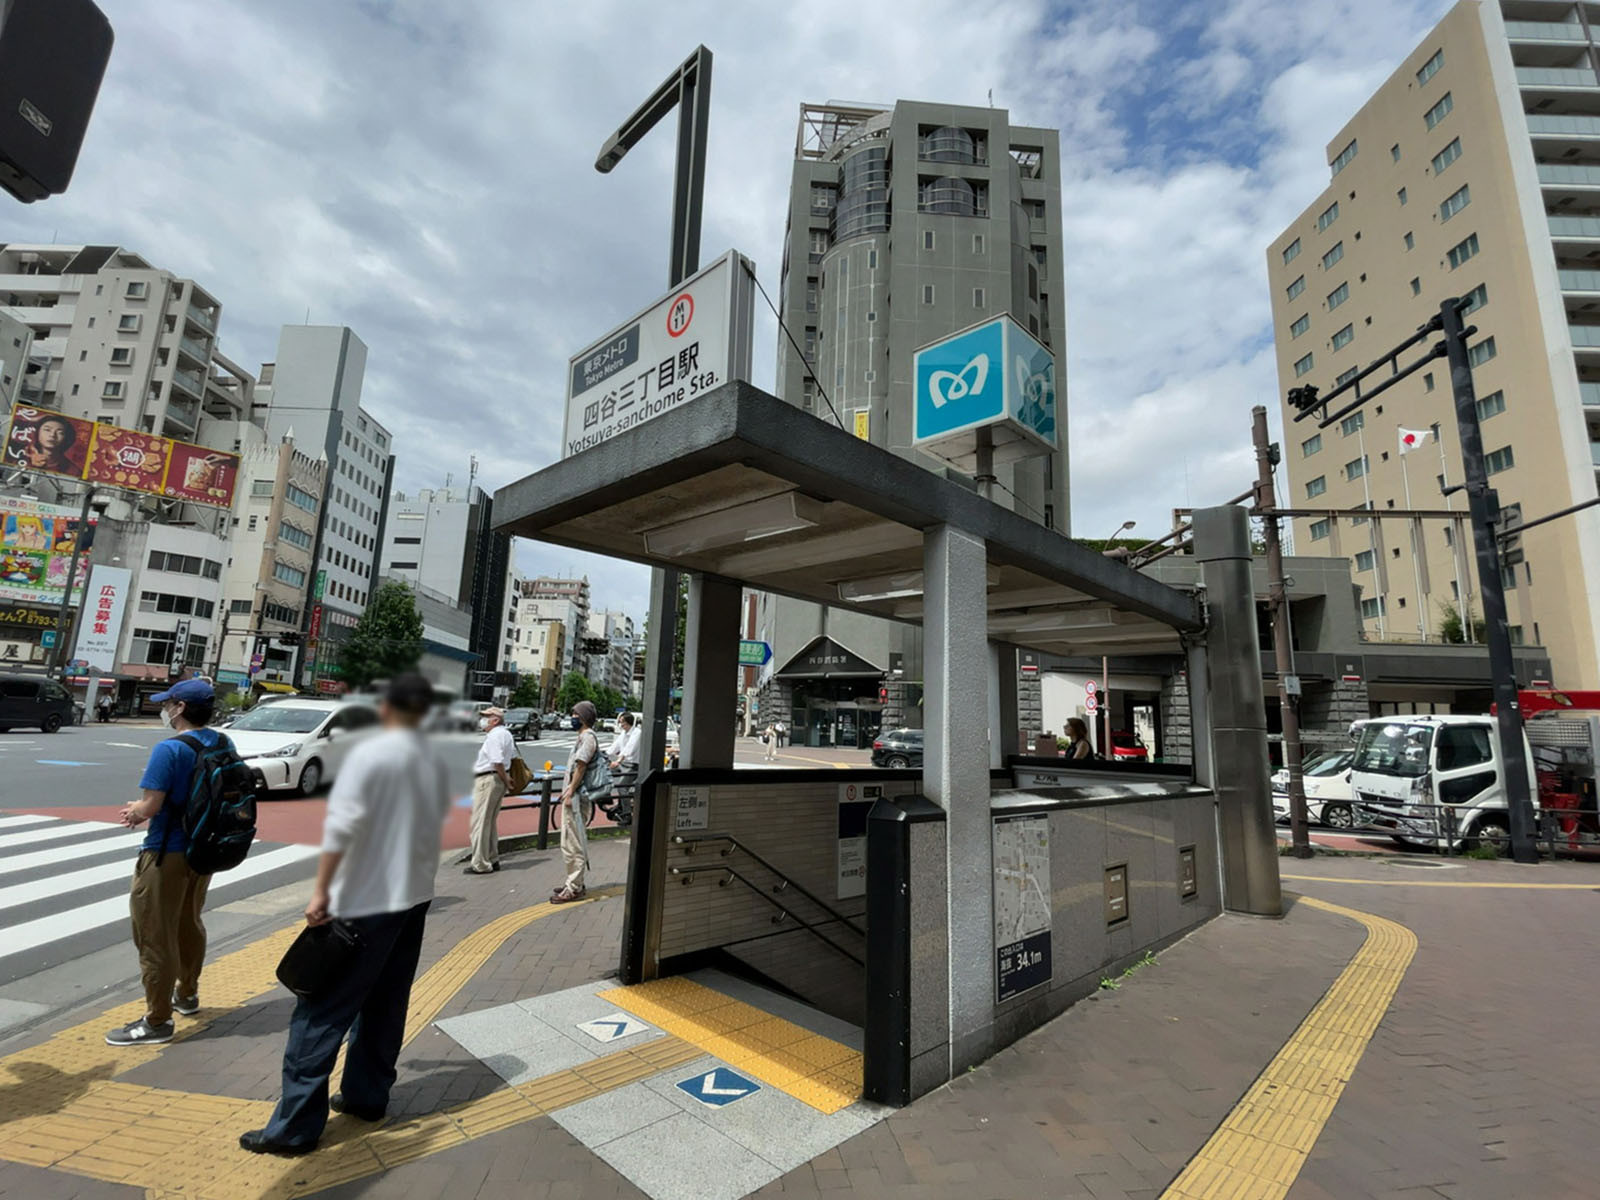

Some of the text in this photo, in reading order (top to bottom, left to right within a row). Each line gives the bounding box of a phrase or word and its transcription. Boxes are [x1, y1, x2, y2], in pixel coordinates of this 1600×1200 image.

[674, 314, 685, 330] 11
[675, 302, 685, 316] M
[583, 337, 628, 377] 東京メトロ
[583, 341, 699, 432] 四谷三丁目駅
[568, 371, 719, 456] Yotsuya-sanchome Sta.
[93, 585, 116, 635] 広告募集
[677, 819, 692, 828] Left
[1016, 951, 1042, 971] 34.1m
